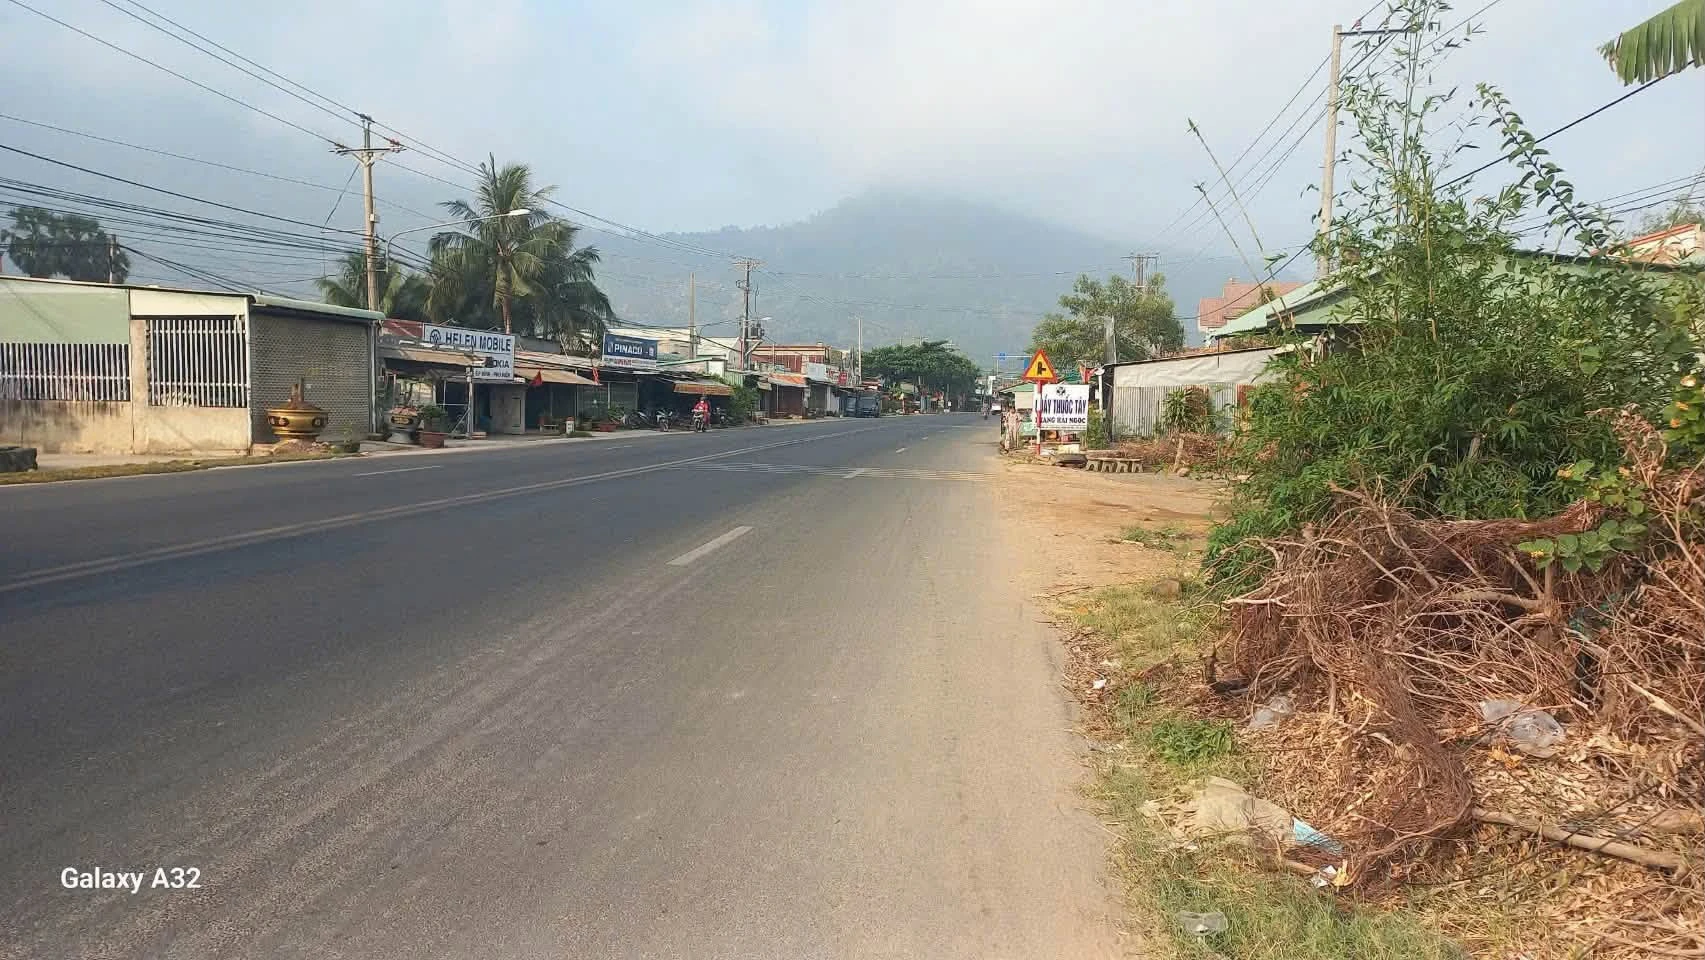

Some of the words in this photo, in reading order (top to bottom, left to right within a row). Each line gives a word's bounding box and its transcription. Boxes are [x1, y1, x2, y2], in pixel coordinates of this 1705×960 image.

[445, 332, 477, 348] HELEN
[479, 336, 511, 352] MOBILE
[614, 343, 643, 355] PINACO
